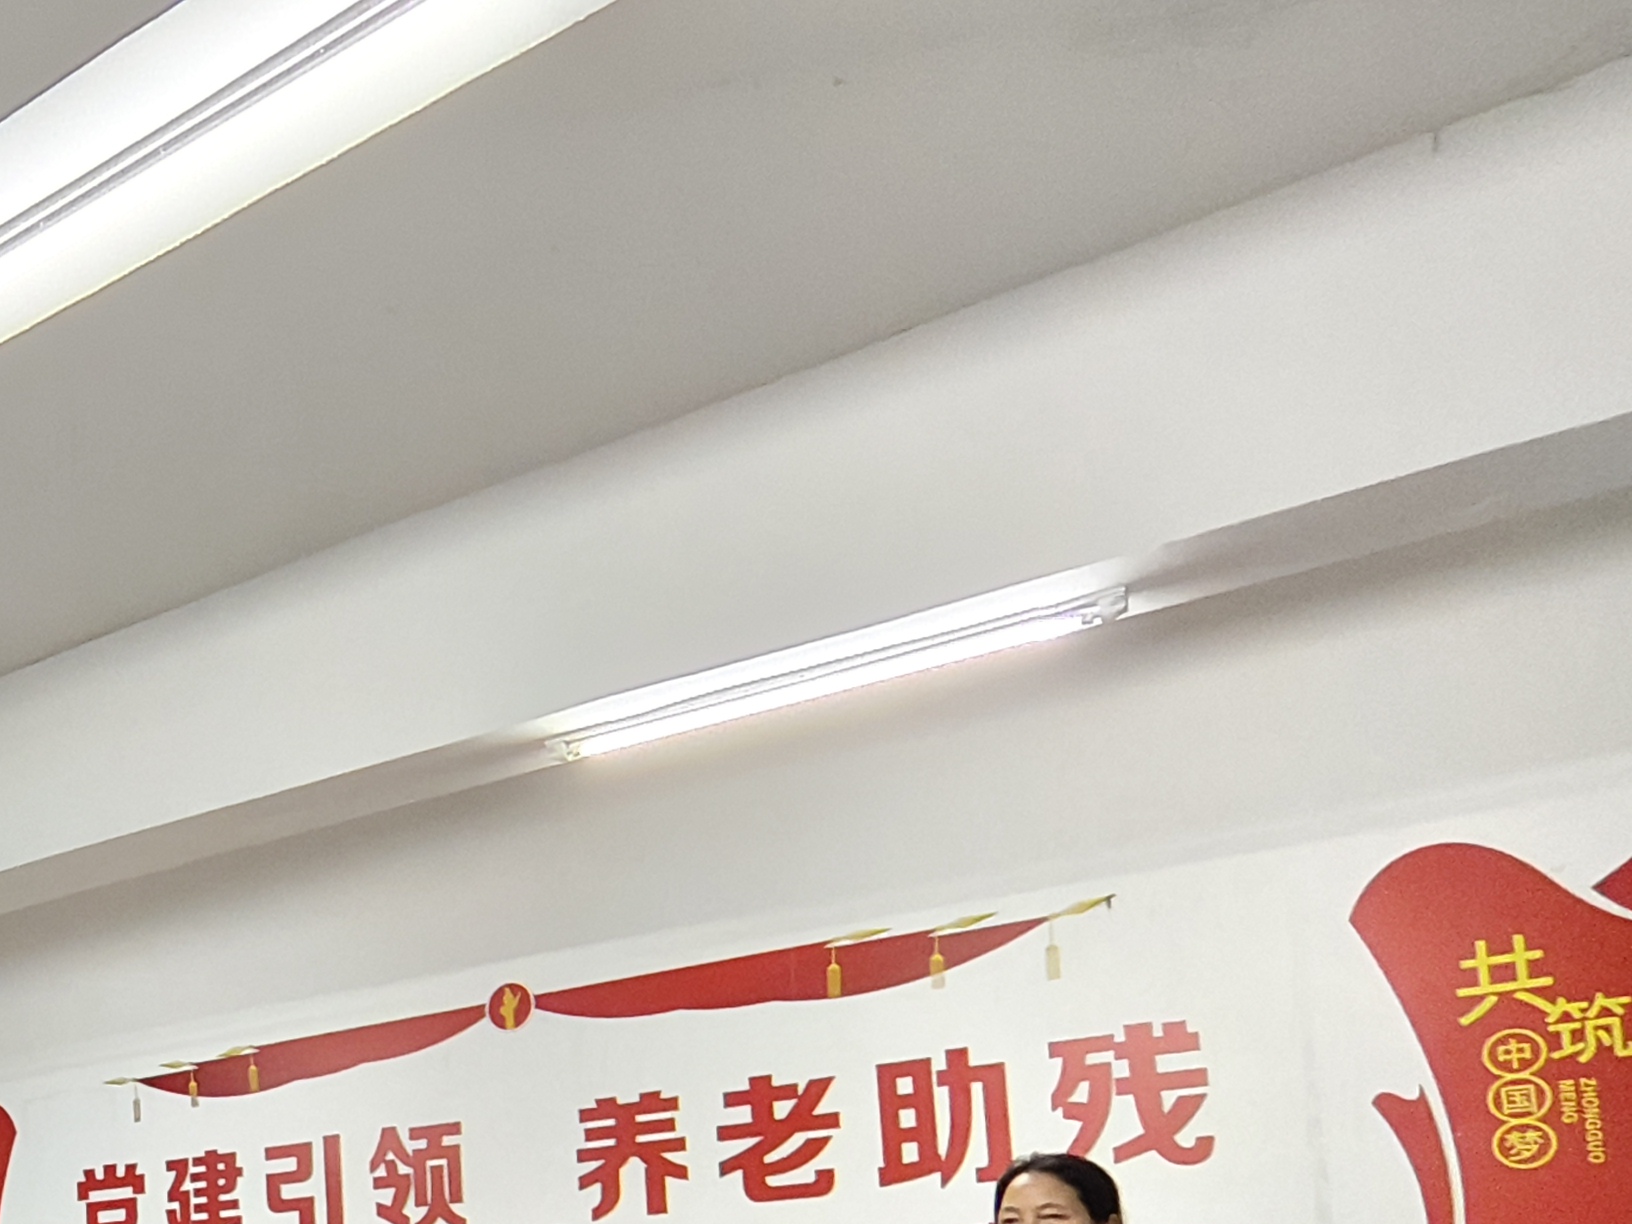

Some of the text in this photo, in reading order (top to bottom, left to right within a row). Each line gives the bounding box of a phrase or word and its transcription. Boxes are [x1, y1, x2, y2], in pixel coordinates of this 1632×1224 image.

[1456, 934, 1632, 1063] 共筑
[576, 1020, 1215, 1220] 养老助残
[1490, 1035, 1551, 1164] 中国梦
[1558, 1077, 1606, 1164] ZHONGGUO MENG
